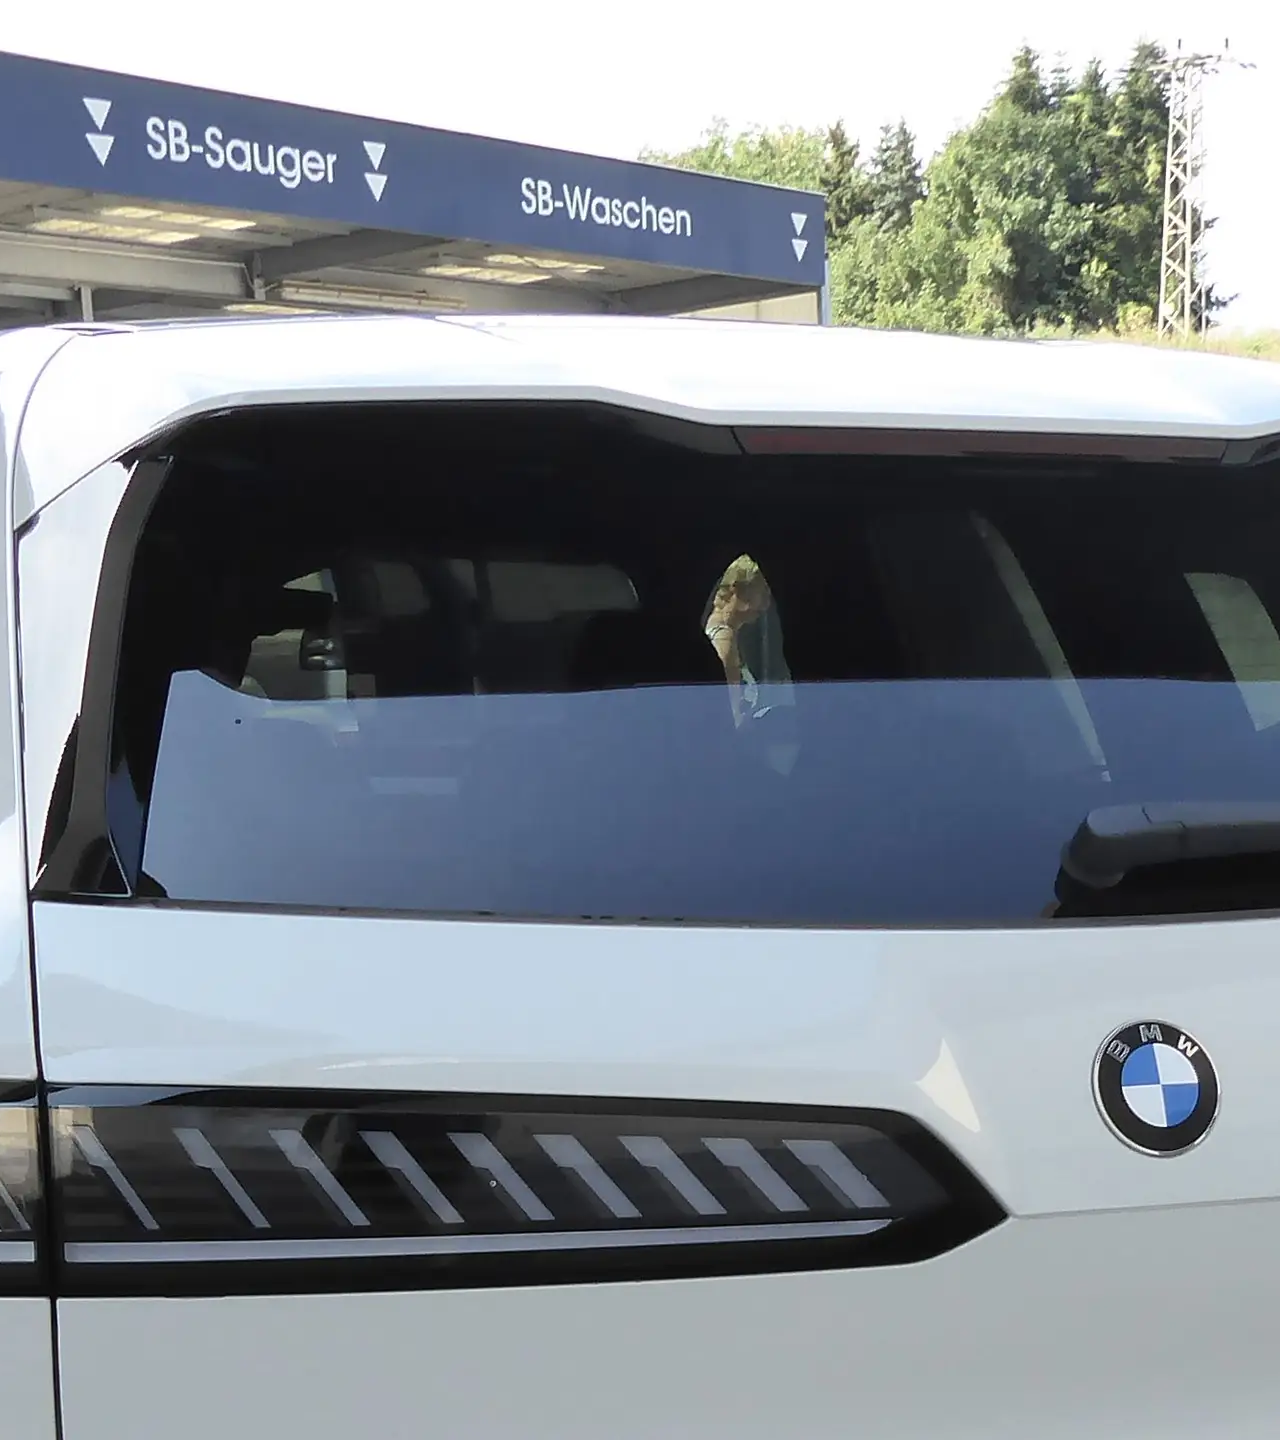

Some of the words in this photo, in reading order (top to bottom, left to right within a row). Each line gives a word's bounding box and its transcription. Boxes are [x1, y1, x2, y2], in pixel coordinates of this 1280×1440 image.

[146, 116, 337, 188] SB-Sauger
[521, 177, 692, 237] SB-Waschen
[1106, 1024, 1199, 1062] BMW
